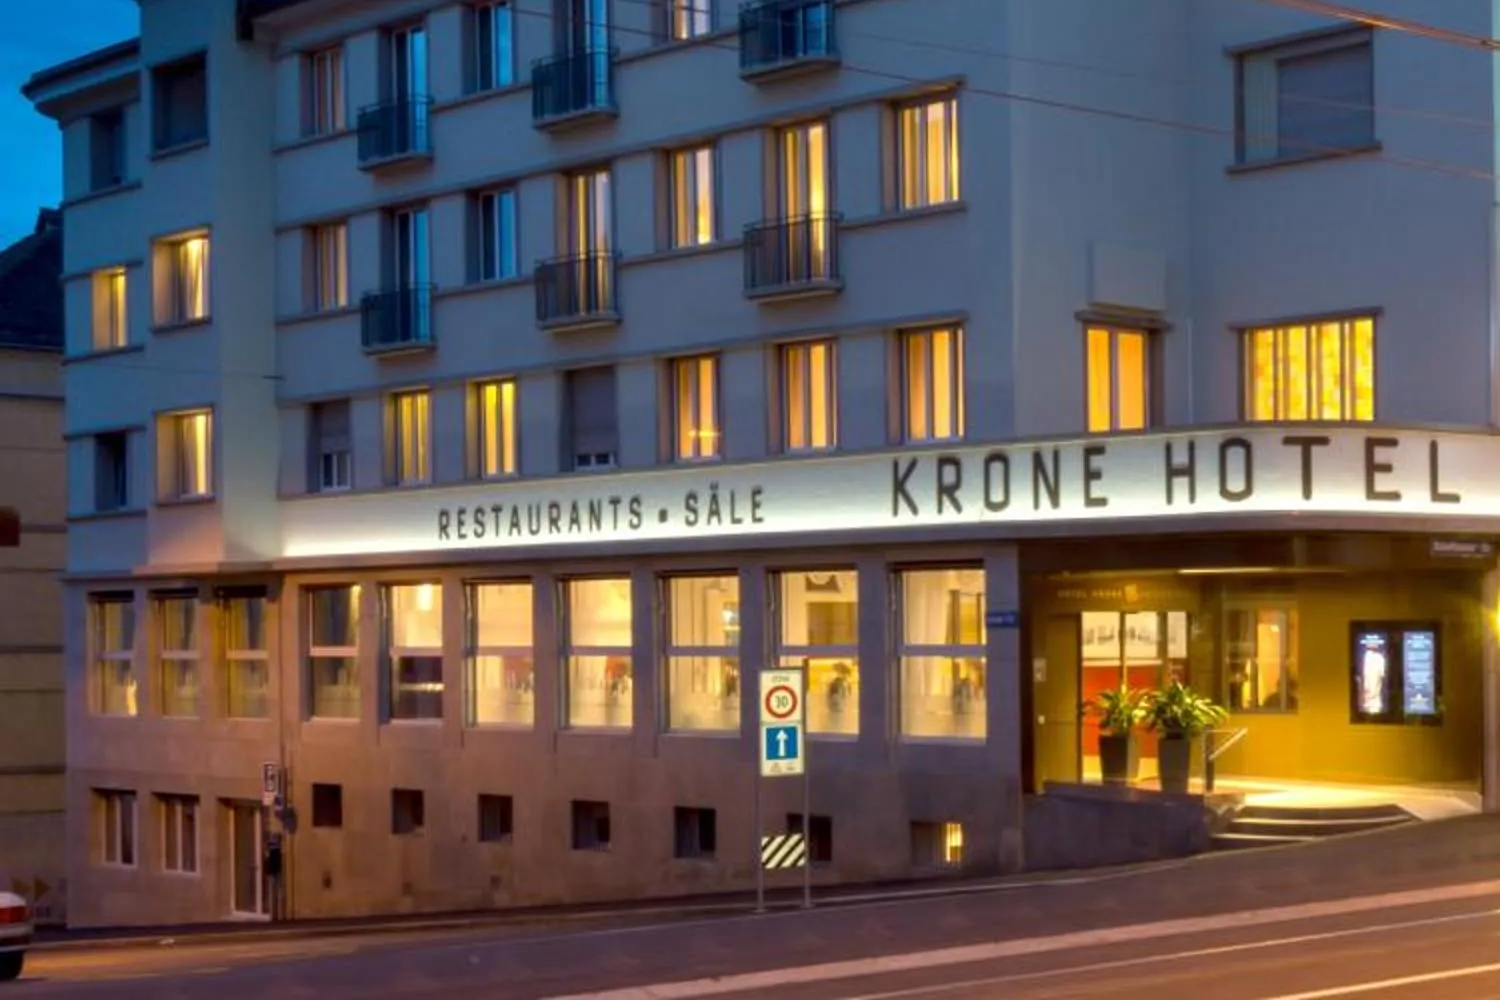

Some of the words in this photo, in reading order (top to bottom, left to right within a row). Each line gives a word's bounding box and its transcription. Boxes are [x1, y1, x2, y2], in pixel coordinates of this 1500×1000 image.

[891, 445, 1108, 518] KRONE
[1165, 436, 1462, 506] HOTEL
[437, 494, 644, 541] RESTAURANTS
[684, 480, 766, 527] SÄLE
[775, 695, 789, 708] 30
